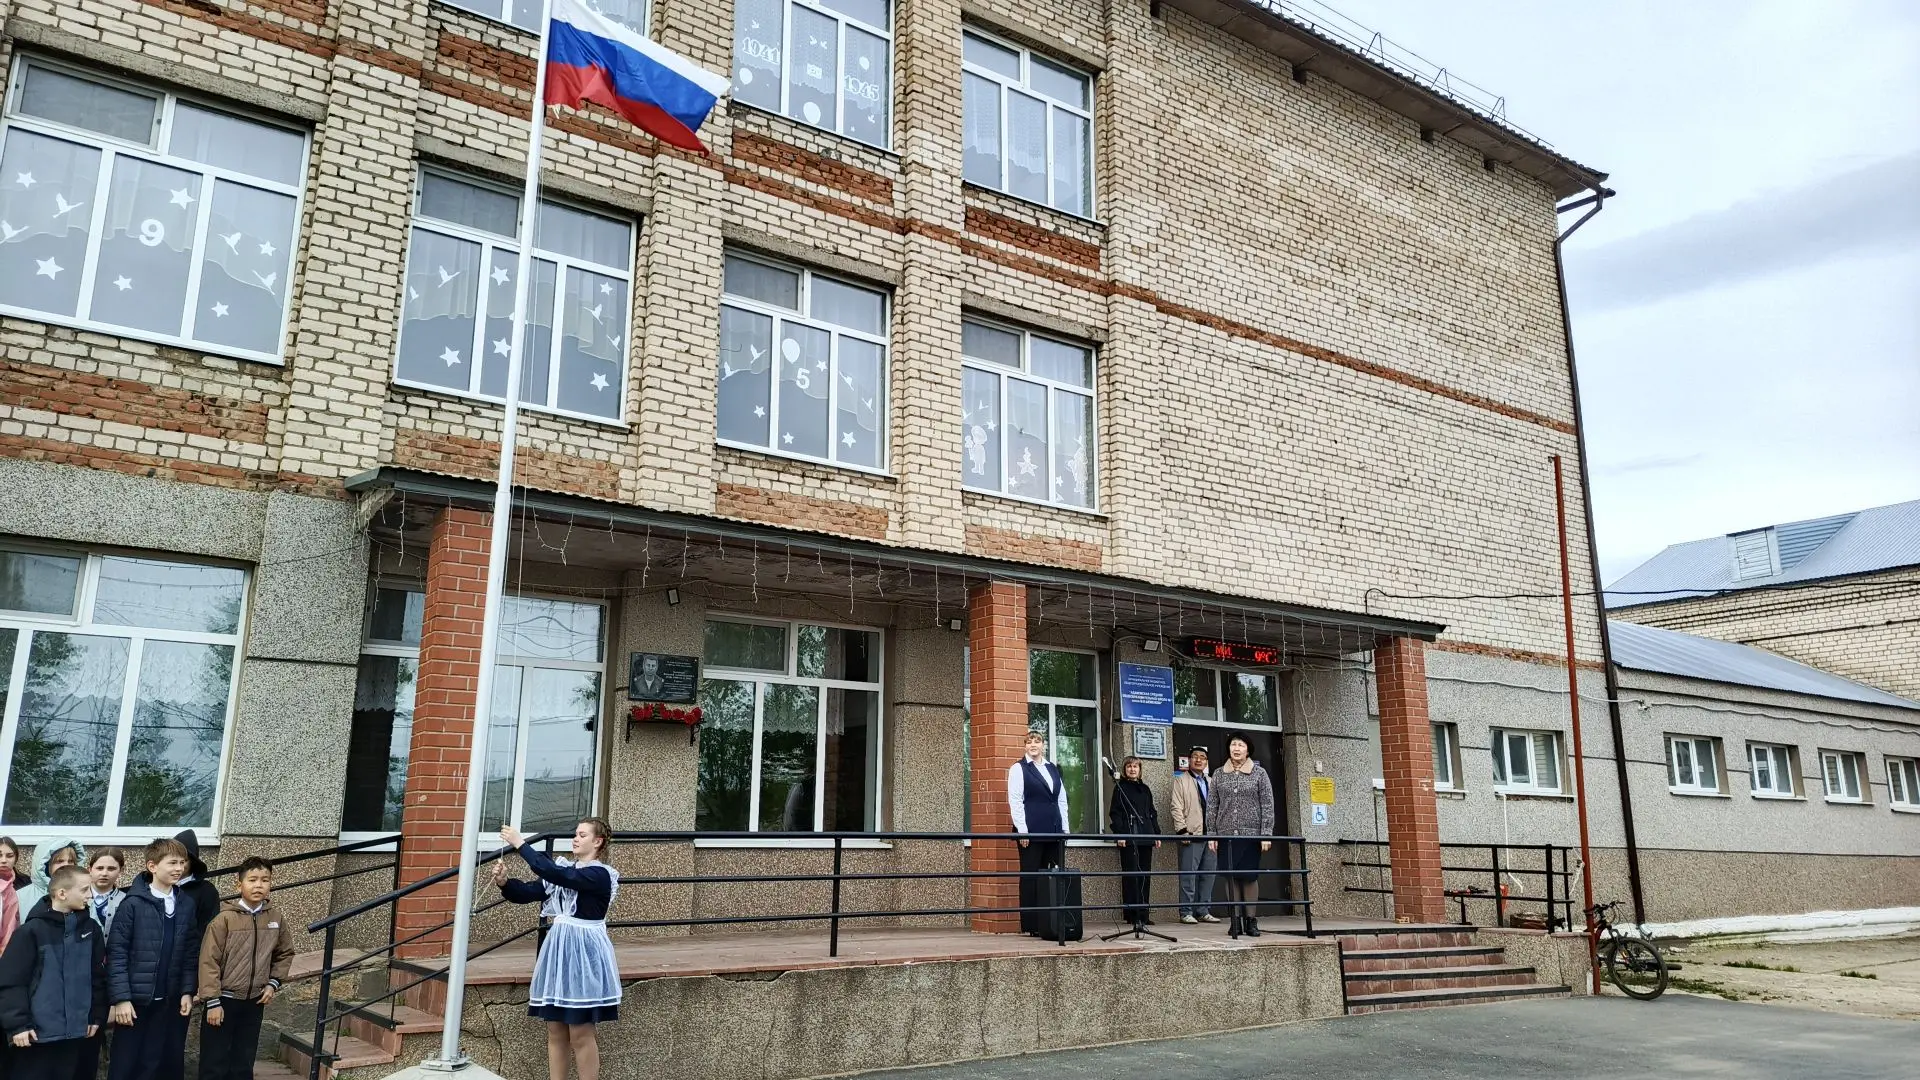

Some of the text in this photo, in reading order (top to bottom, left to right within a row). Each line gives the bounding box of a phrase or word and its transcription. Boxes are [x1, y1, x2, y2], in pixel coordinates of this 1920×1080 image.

[742, 37, 780, 65] 1941
[844, 75, 879, 101] 1945
[139, 218, 165, 247] 9
[796, 368, 810, 389] 5
